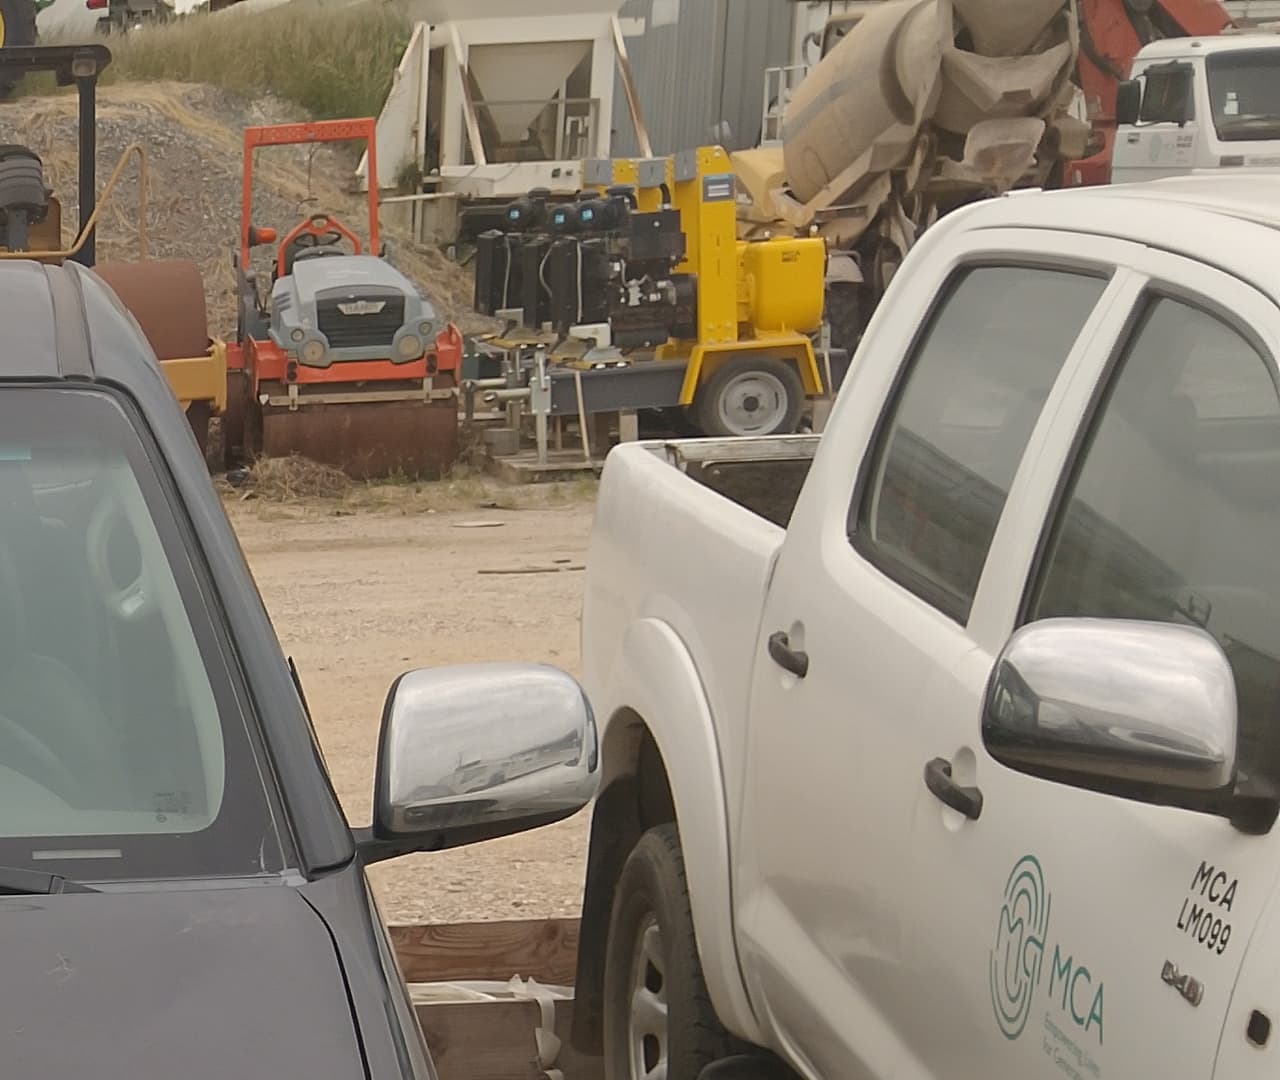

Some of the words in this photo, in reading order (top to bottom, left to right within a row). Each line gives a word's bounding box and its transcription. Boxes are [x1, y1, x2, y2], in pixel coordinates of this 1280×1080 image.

[1190, 860, 1238, 912] MCA
[1176, 897, 1231, 955] LM099
[1048, 943, 1104, 1046] MCA
